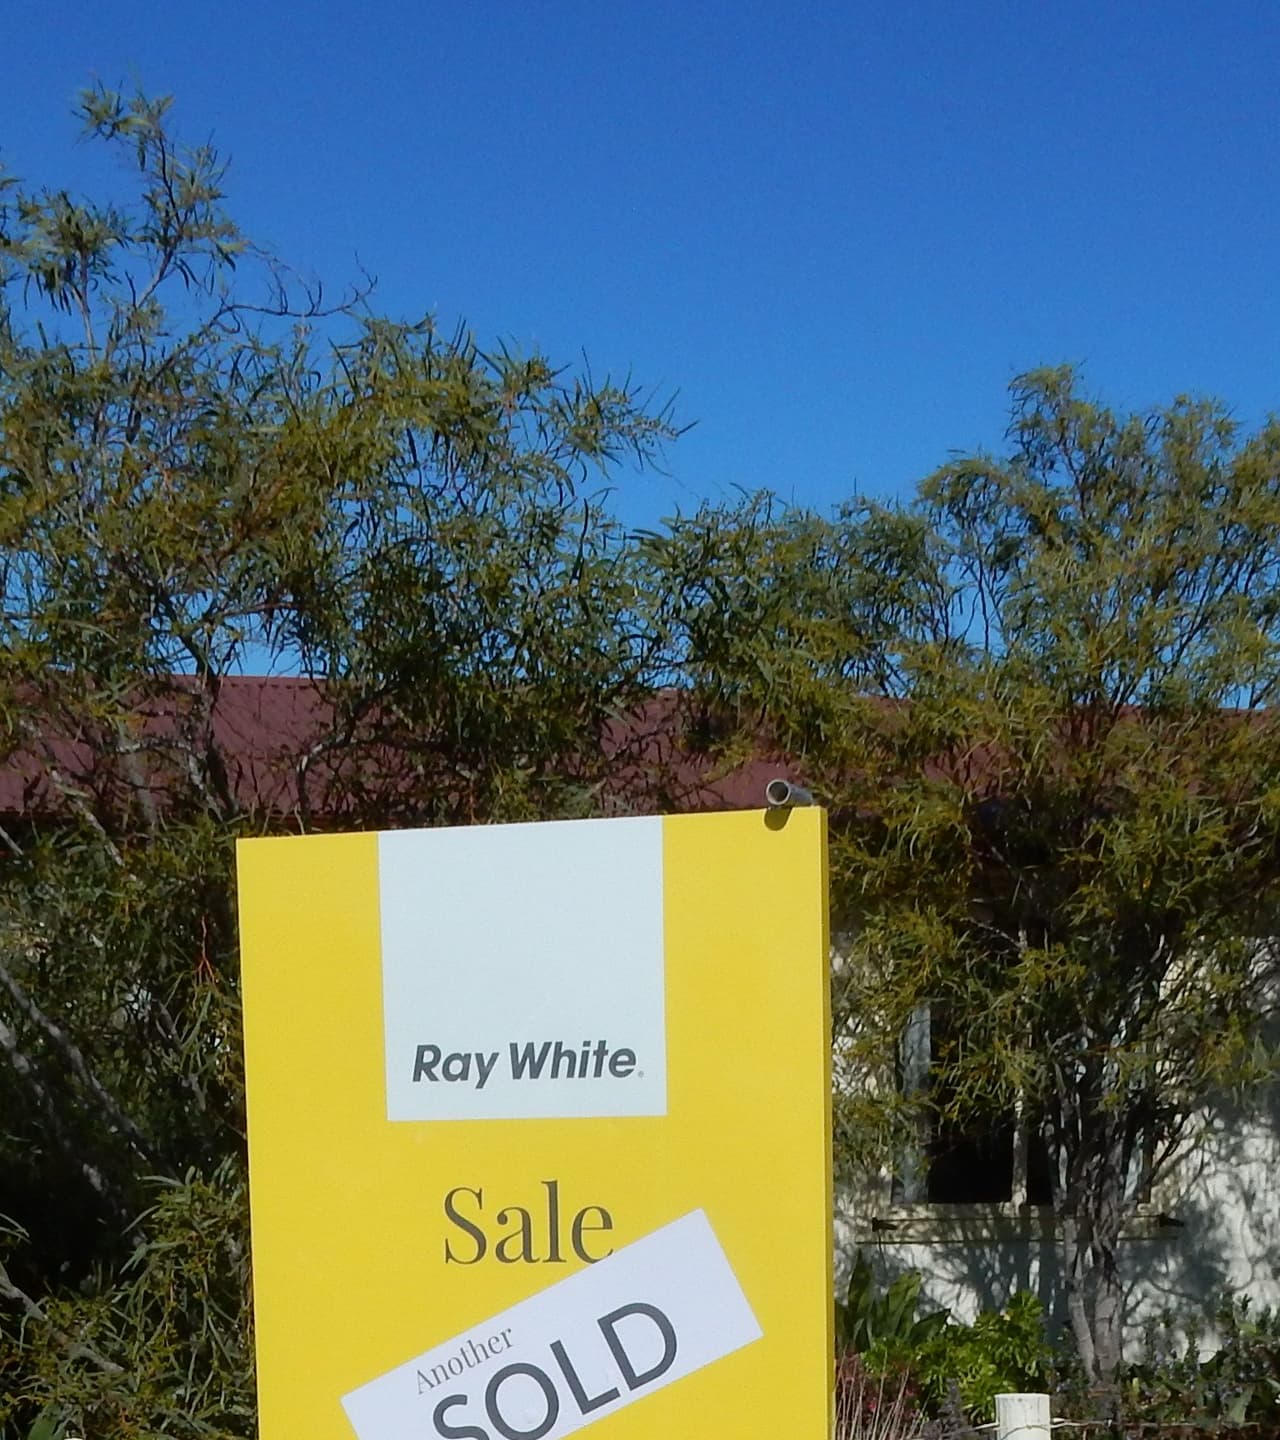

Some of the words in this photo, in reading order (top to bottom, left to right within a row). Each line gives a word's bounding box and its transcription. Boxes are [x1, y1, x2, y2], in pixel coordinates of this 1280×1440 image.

[412, 1044, 500, 1089] Ray
[509, 1039, 637, 1080] White
[443, 1179, 614, 1265] Sale
[416, 1326, 514, 1395] Another
